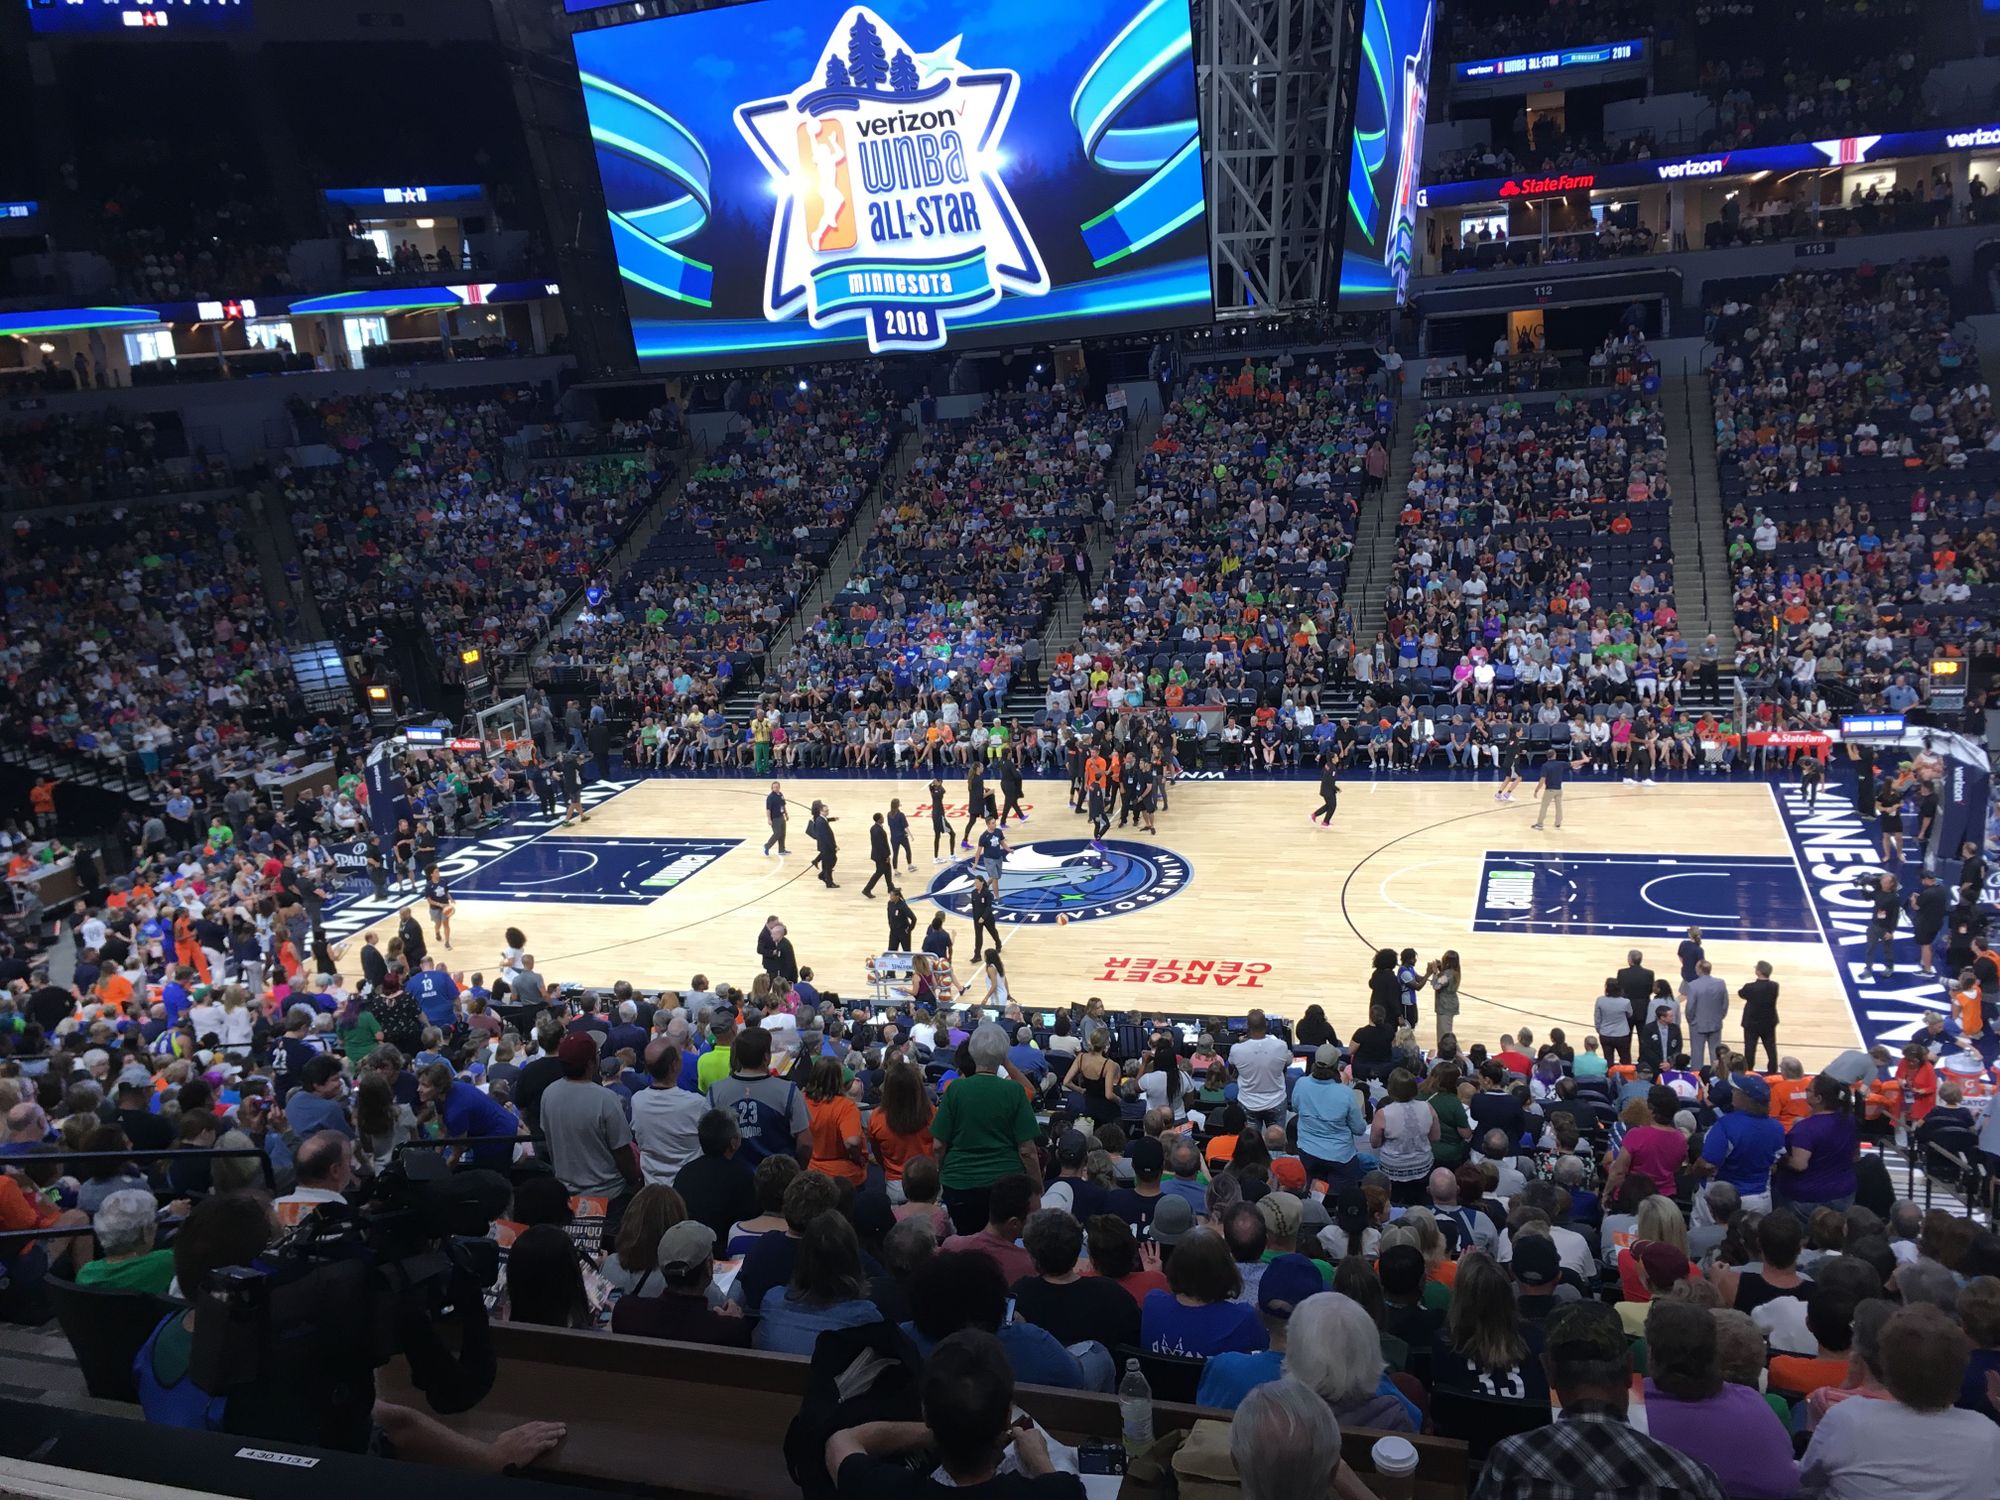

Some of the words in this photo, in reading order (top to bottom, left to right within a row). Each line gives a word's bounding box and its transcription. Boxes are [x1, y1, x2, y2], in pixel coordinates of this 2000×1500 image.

[1612, 45, 1631, 59] 2018
[856, 109, 955, 138] verizon
[858, 130, 969, 194] WNBA
[1658, 158, 1722, 179] verizon
[1805, 244, 1826, 254] 113
[1534, 285, 1553, 296] 112
[885, 310, 928, 337] 2018
[1953, 766, 1966, 802] verizon
[1104, 957, 1273, 974] CENTER
[422, 978, 433, 992] 13
[1093, 969, 1265, 988] TARGET
[738, 1100, 758, 1124] 23
